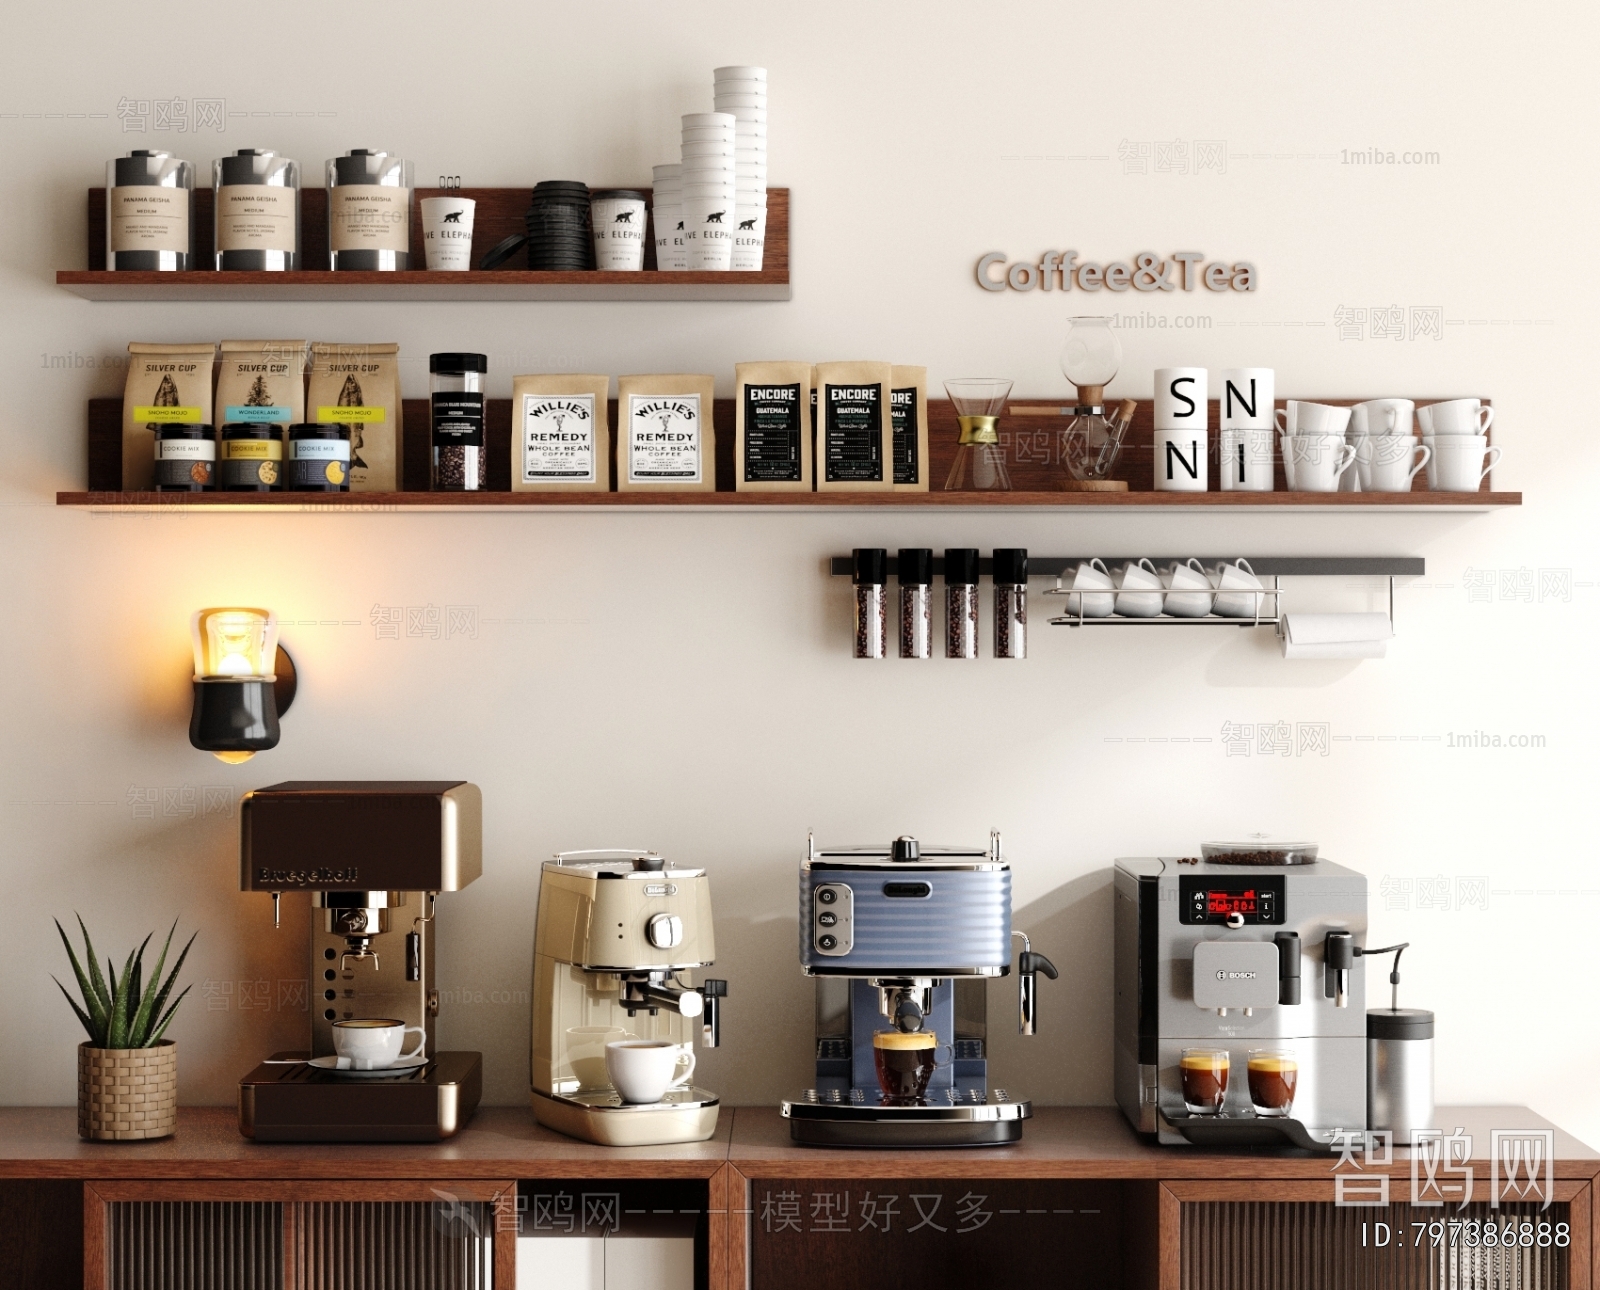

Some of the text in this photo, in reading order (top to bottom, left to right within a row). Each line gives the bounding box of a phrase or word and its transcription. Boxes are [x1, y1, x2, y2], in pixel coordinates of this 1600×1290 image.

[975, 250, 1258, 292] Coffee&Tea
[145, 364, 197, 372] SILVER CUP
[237, 364, 288, 372] SILVER CUP
[328, 364, 380, 372] SILVER CUP
[750, 388, 796, 401] ENCORE
[831, 388, 877, 401] ENCORE
[891, 392, 913, 404] ORE
[1170, 377, 1196, 417] S
[1226, 378, 1257, 419] N
[529, 401, 590, 420] WILLIE'S
[634, 401, 696, 420] WILLIE'S
[530, 433, 588, 441] REMEDY
[636, 433, 694, 441] REMEDY
[528, 444, 590, 452] WHOLE BEAN
[634, 444, 696, 452] WHOLE BEAN
[1166, 440, 1198, 480] N
[259, 867, 358, 886] Bruegelhoff
